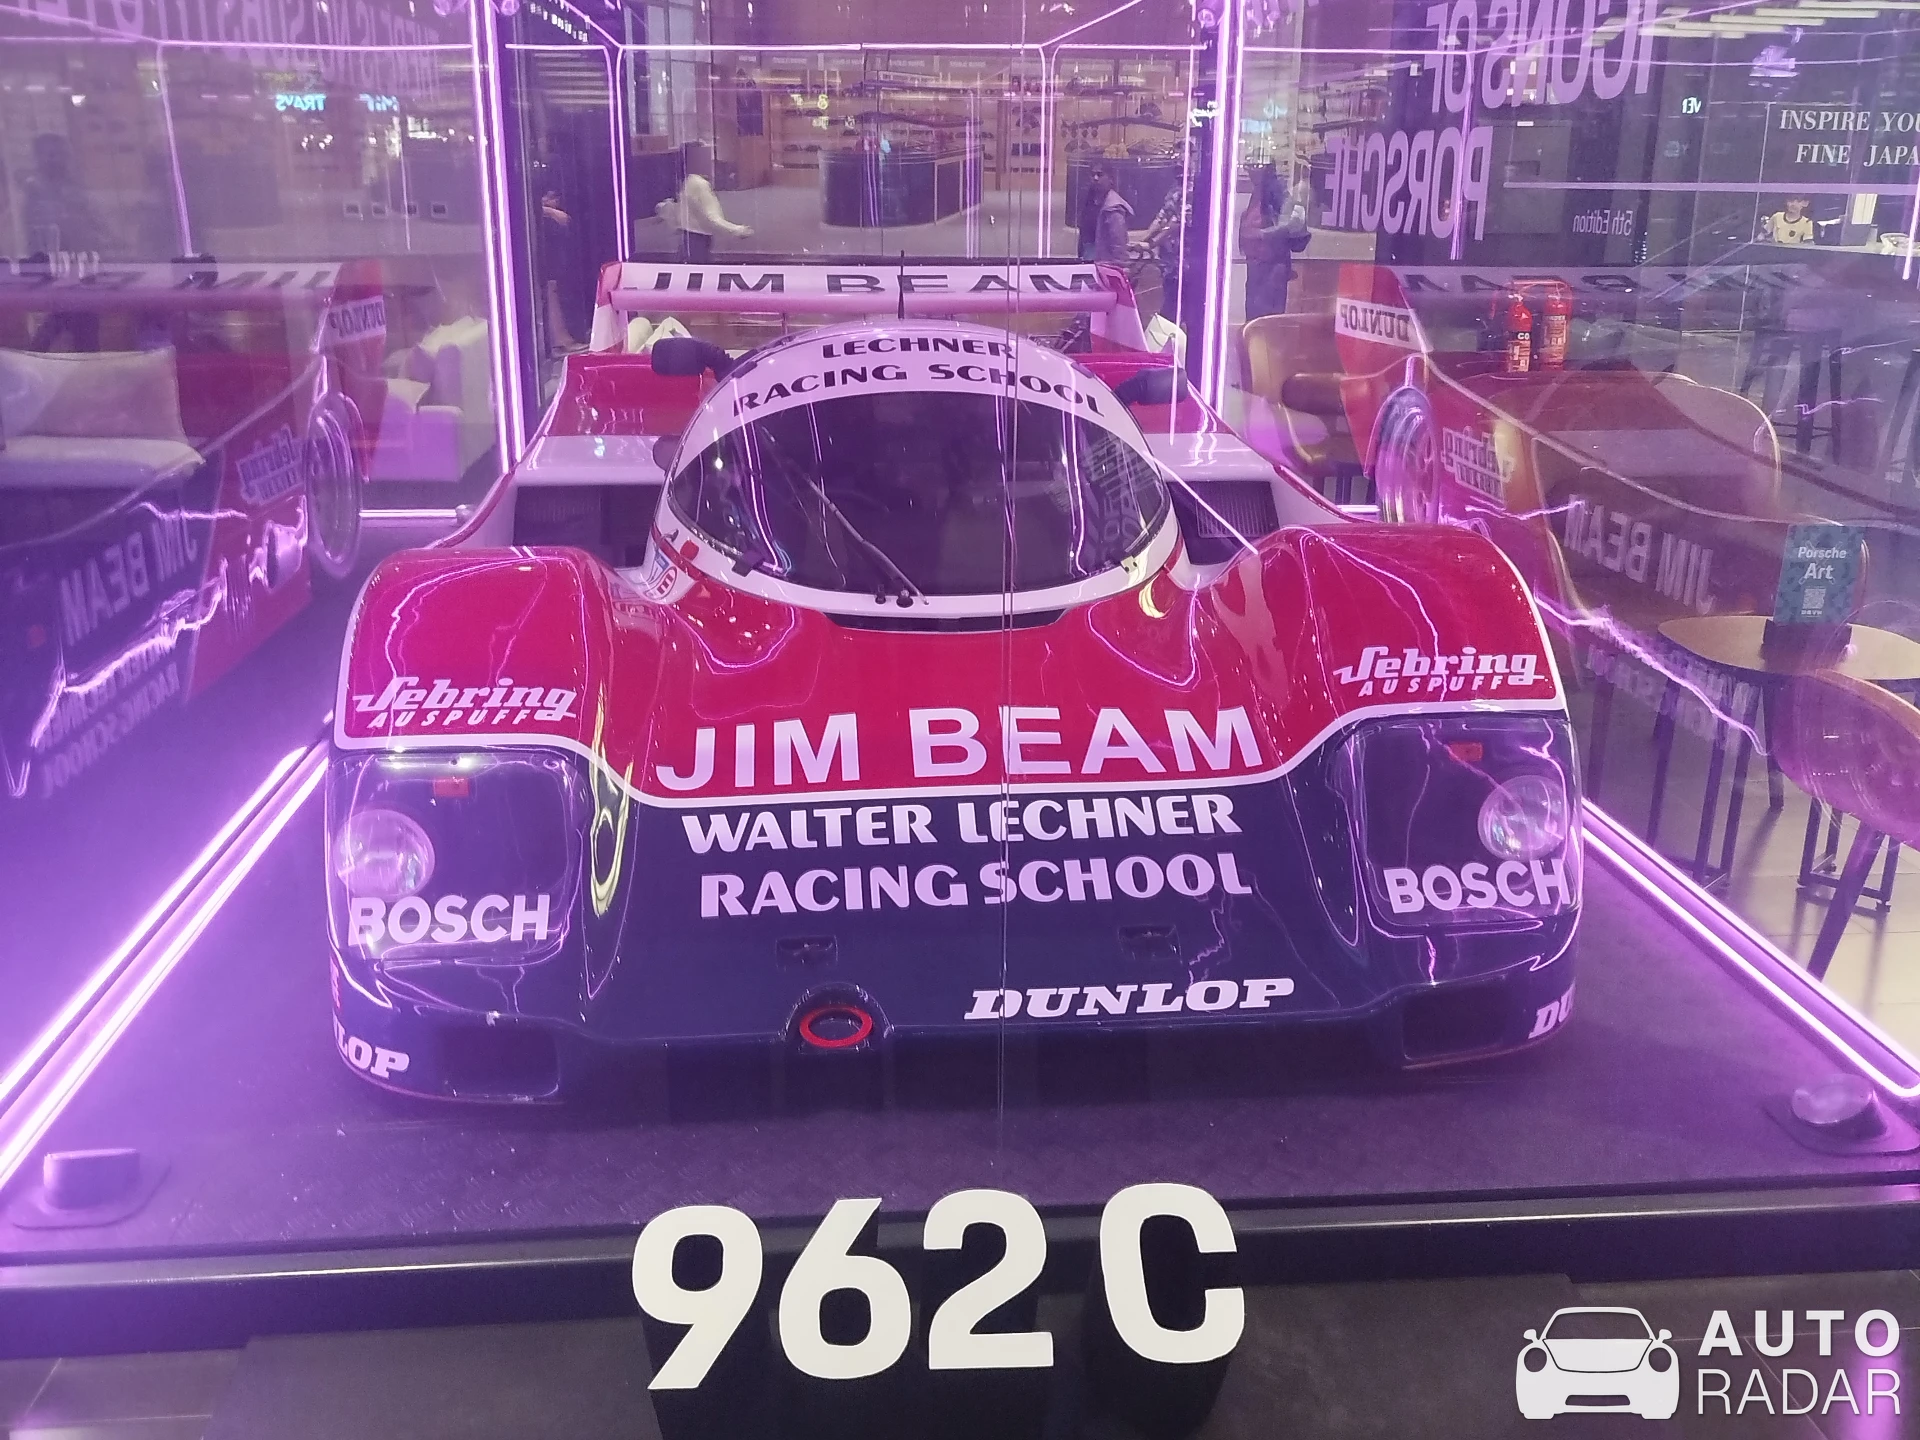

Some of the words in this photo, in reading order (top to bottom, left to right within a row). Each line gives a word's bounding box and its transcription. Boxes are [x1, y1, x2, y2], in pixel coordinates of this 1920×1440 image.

[1778, 108, 1871, 131] INSPIRE
[1794, 143, 1852, 164] FINE
[622, 271, 787, 293] JIM
[825, 273, 1102, 294] BEAM
[821, 336, 1016, 360] LECHNER
[732, 364, 907, 417] RACING
[928, 363, 1106, 418] SCHOOL
[1798, 546, 1847, 559] Porsche
[1804, 563, 1834, 580] Art
[1333, 646, 1545, 685] Sebring
[1358, 675, 1503, 697] AUSPUFF
[352, 676, 577, 721] Sebring
[367, 709, 531, 729] AUSPUFF
[655, 713, 861, 791] JIM
[909, 705, 1263, 779] BEAM
[682, 803, 937, 854] WALTER
[958, 794, 1243, 844] LECHNER
[701, 864, 969, 918] RACING
[979, 852, 1253, 904] SCHOOL
[1383, 858, 1572, 914] BOSCH
[348, 893, 551, 946] BOSCH
[964, 977, 1295, 1020] DUNLOP
[333, 1010, 410, 1079] LOP
[632, 1189, 1054, 1390] 962
[1100, 1182, 1246, 1364] C
